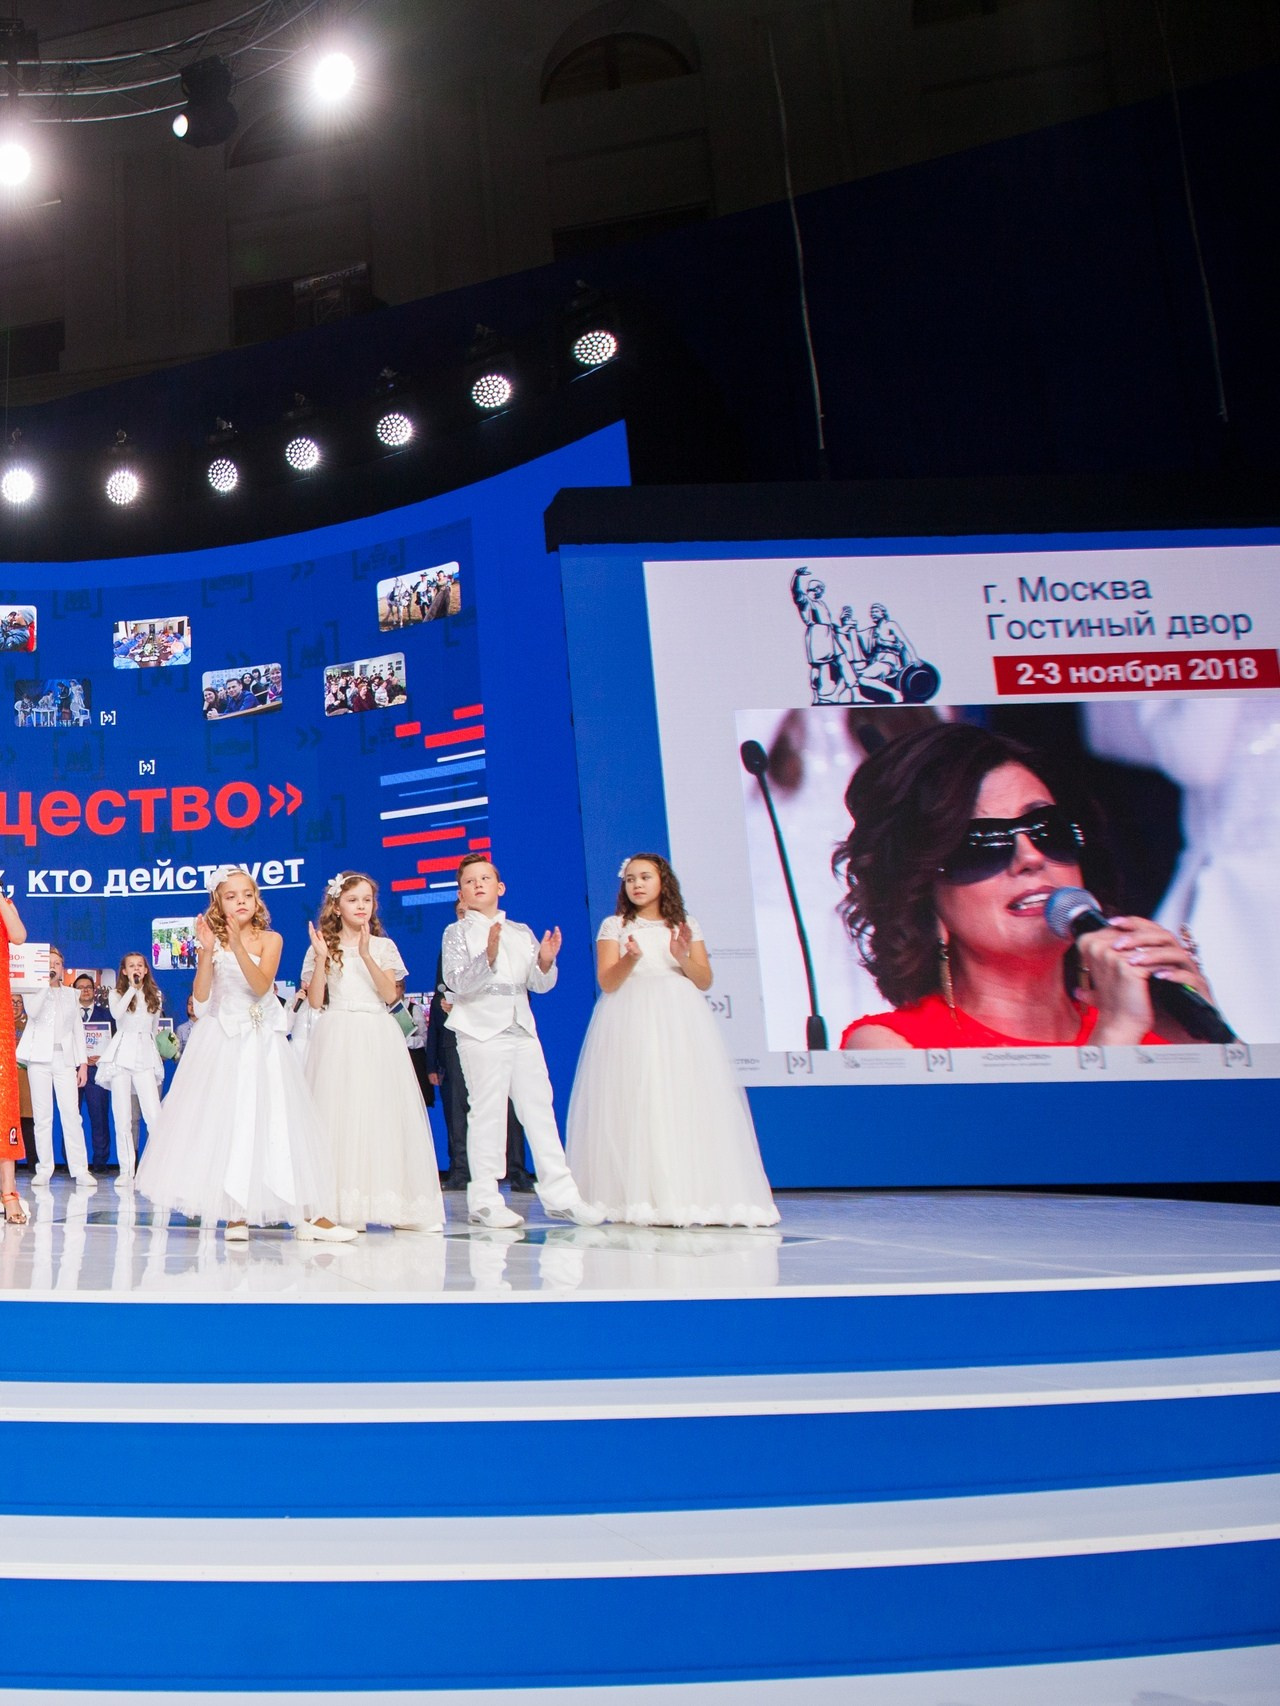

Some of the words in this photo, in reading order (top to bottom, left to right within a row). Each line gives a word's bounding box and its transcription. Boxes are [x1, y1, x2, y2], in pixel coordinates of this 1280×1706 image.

[983, 584, 1006, 604] г.
[1018, 576, 1152, 602] Москва
[986, 609, 1156, 640] Гостиный
[1167, 613, 1253, 640] двор
[1016, 662, 1062, 685] 2-3
[1069, 659, 1182, 688] ноября
[1187, 657, 1258, 681] 2018
[28, 868, 92, 893] кто
[103, 858, 305, 898] дейстует
